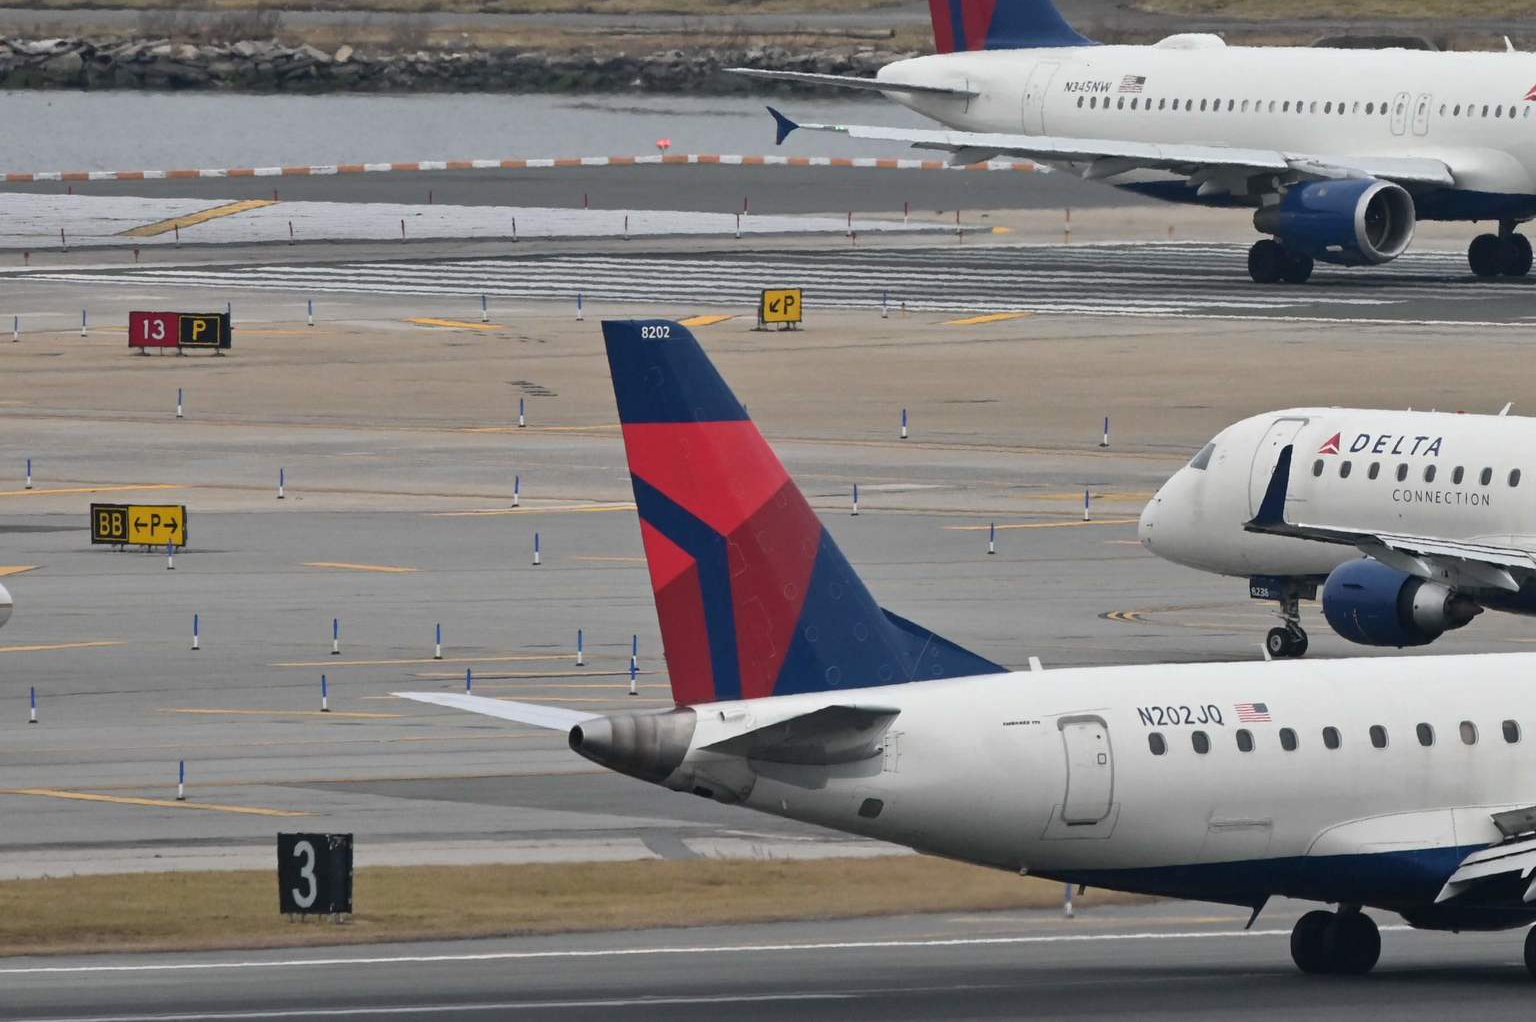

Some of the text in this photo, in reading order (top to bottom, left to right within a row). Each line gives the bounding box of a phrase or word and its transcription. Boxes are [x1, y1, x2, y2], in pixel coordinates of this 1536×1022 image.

[1064, 81, 1112, 93] N345NW
[784, 295, 795, 315] P
[143, 319, 206, 341] 13 P
[641, 325, 670, 339] 8202
[1349, 433, 1443, 457] DELTA
[1392, 489, 1490, 507] CONNECTION
[100, 512, 161, 537] BB P
[1137, 704, 1225, 727] N202JQ
[292, 840, 318, 909] 3
